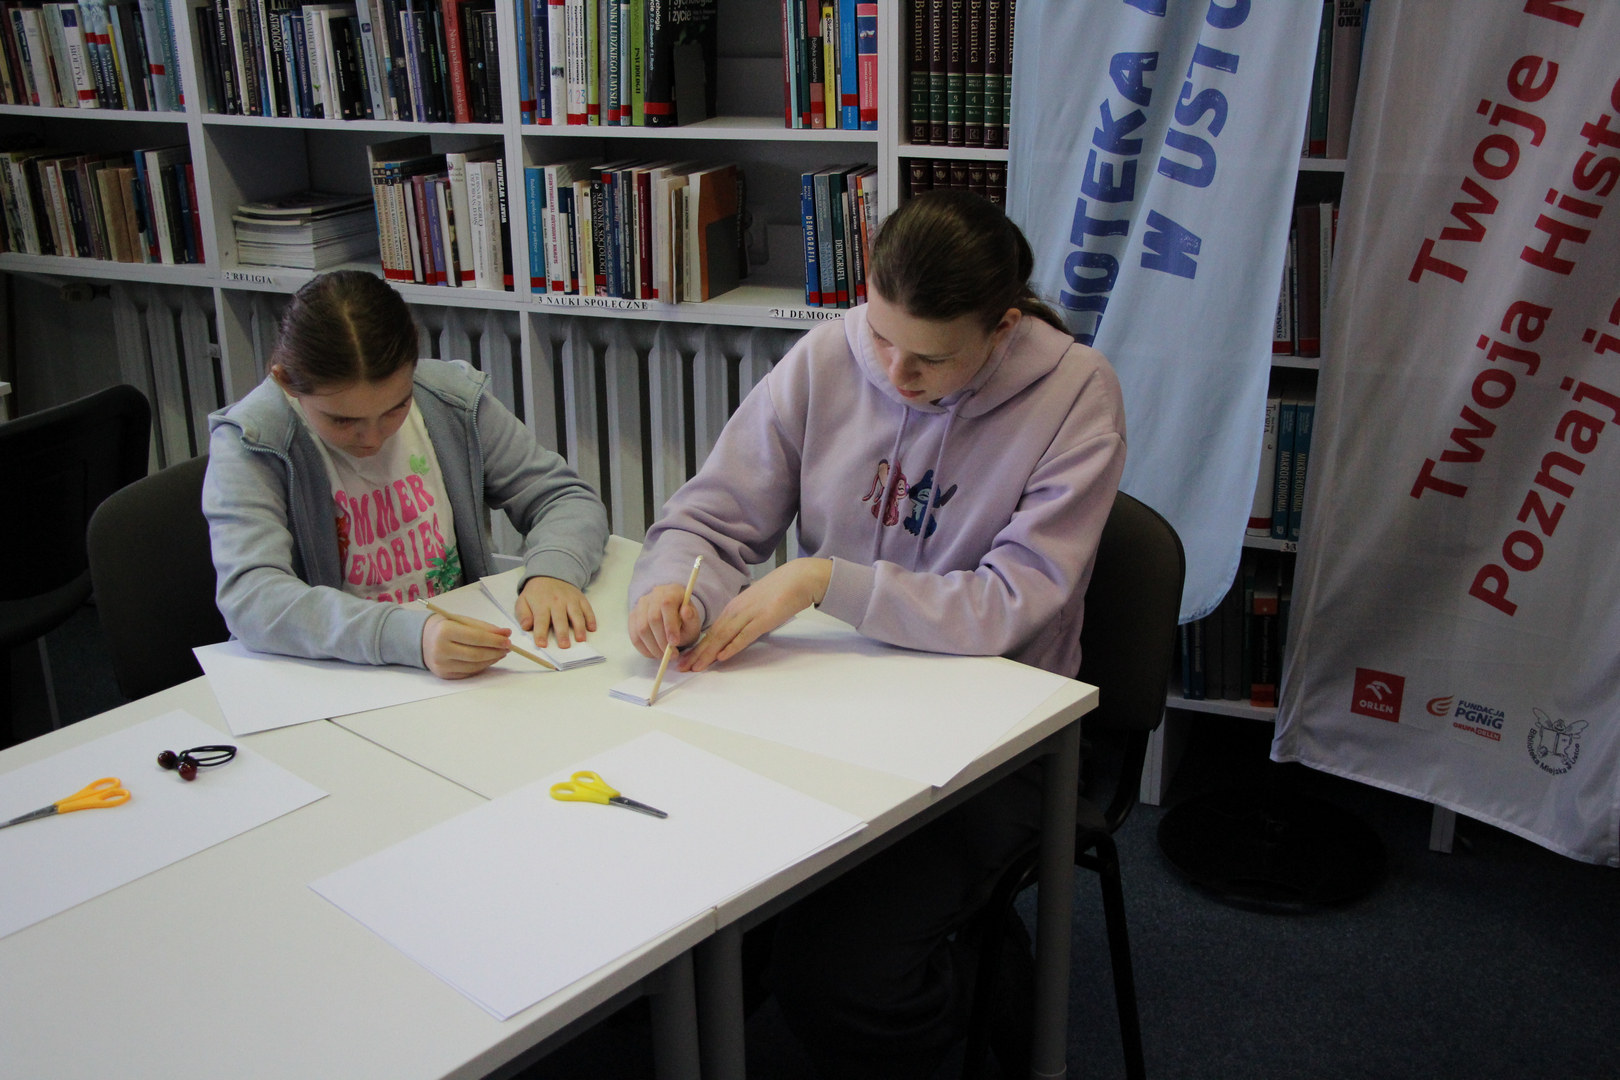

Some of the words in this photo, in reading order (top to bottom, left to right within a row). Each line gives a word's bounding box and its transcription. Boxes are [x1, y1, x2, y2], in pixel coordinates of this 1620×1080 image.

[269, 13, 282, 52] ASTROLOGIA
[672, 7, 692, 24] życie
[915, 0, 926, 61] Britannica
[933, 0, 943, 62] Britannica
[951, 0, 963, 63] Britannica
[970, 0, 982, 63] Britannica
[989, 0, 1000, 64] Britannica
[1338, 17, 1360, 27] ONZ
[449, 28, 458, 49] Nowa
[609, 25, 617, 72] LUDZKIEGO
[576, 90, 580, 104] 2
[581, 90, 586, 104] 3
[610, 74, 618, 107] UMYSŁU
[953, 95, 958, 103] 3
[3, 158, 11, 171] ERIC
[496, 159, 505, 197] WYZNANIA
[1408, 55, 1559, 283] Twoje
[1520, 77, 1620, 276] Hist
[597, 192, 605, 228] SŁOWNIK
[1058, 52, 1159, 326] IOTEKA
[598, 230, 606, 275] SOCJOLOGII
[805, 215, 815, 263] DEMOGRAFIA
[835, 239, 845, 281] DEMOGRAFIA
[1140, 209, 1202, 280] W
[233, 273, 272, 284] RELIGIA
[538, 296, 543, 305] 3
[546, 296, 581, 307] NAUKI
[584, 298, 649, 310] SPOŁECZNE
[774, 309, 784, 317] 31
[1410, 300, 1553, 499] Twoja
[1277, 451, 1290, 512] MAKROEKONOMIA
[1293, 452, 1306, 512] MIKROEKONOMIA
[1468, 376, 1620, 617] Poznaj
[335, 474, 434, 547] MMER
[1359, 699, 1394, 714] ORLEN
[1454, 707, 1504, 730] PGNiG
[1458, 700, 1505, 718] FUNDACJA
[1453, 722, 1475, 733] GRUPA
[1476, 728, 1500, 740] ORLEN
[1527, 728, 1539, 765] Biblioteka
[1539, 762, 1567, 776] Miejska
